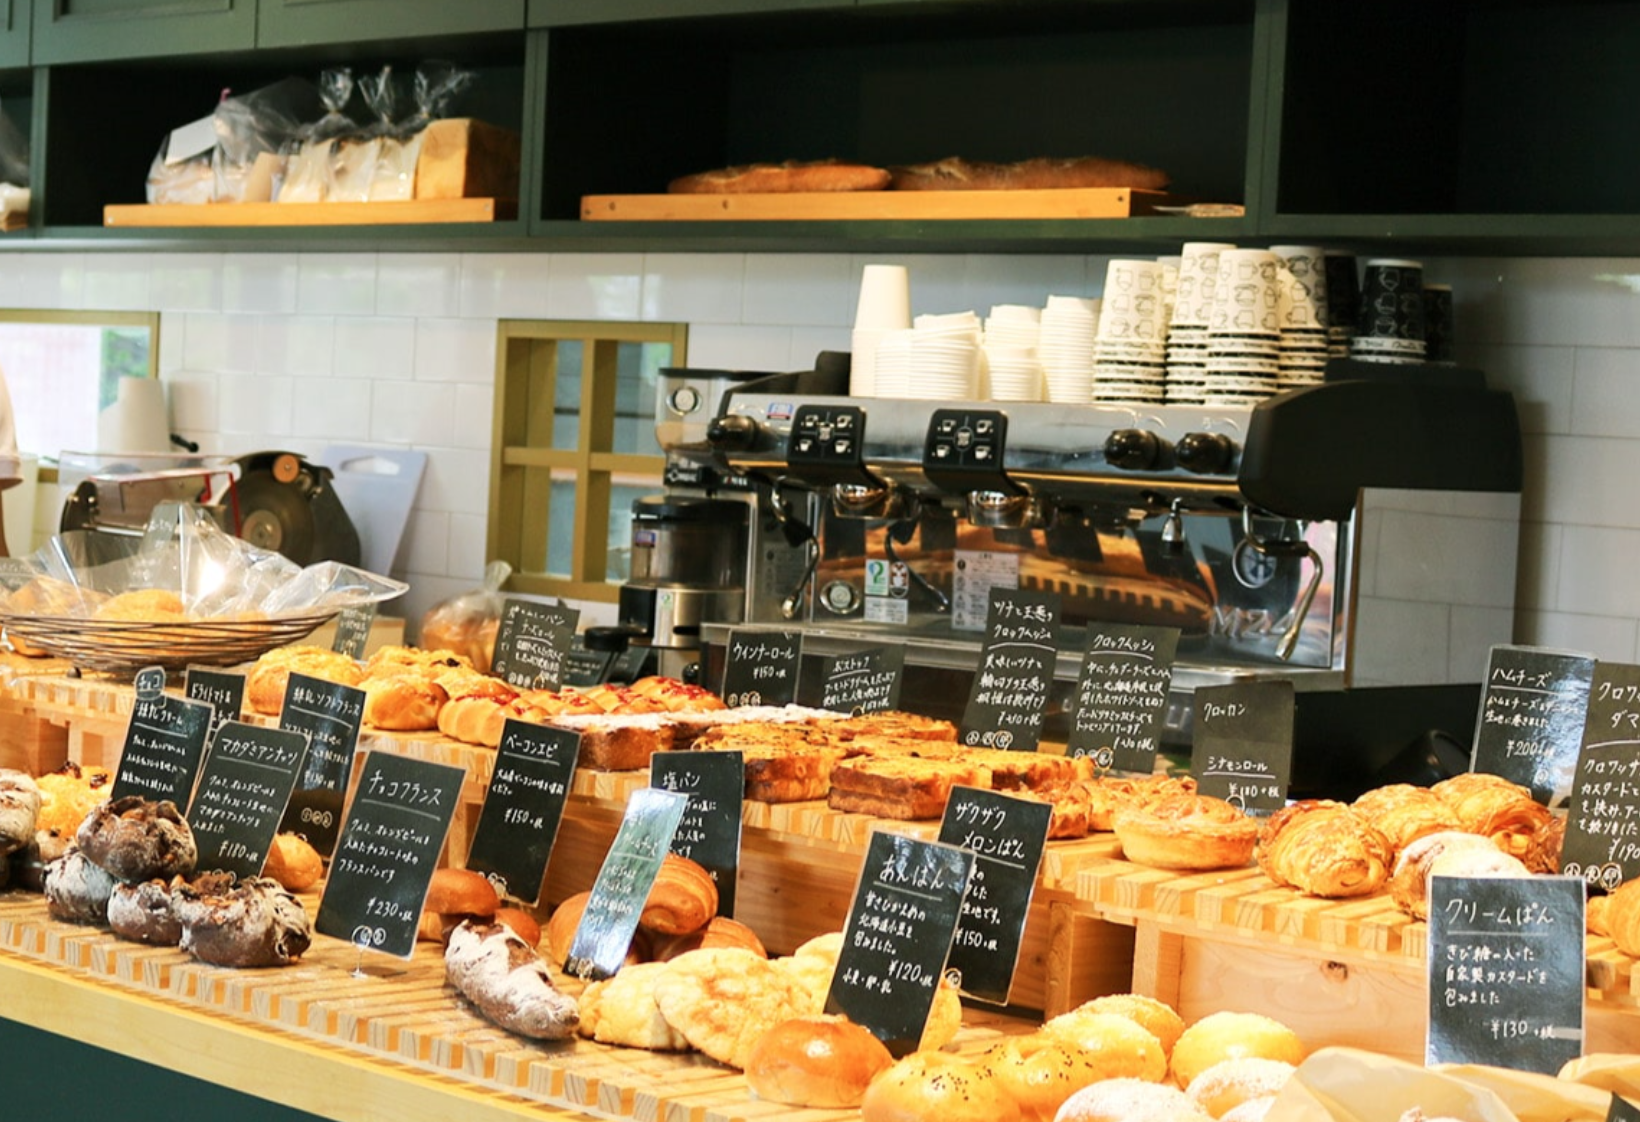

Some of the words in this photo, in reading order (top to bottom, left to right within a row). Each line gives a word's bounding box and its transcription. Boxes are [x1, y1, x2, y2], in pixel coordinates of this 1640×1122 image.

[1491, 667, 1552, 687] ハムチーズ
[221, 738, 298, 766] マカダミアンナッツ
[506, 734, 559, 759] ベーコンエピ
[1207, 756, 1268, 772] シナモンロール
[1584, 759, 1640, 778] クロワッサ
[369, 770, 442, 806] チョコフランス
[662, 771, 701, 790] 塩パン
[955, 802, 1007, 831] ザクザク
[1445, 899, 1554, 926] クリームぱん
[1445, 965, 1548, 985] 自家製カスタードを
[1445, 987, 1500, 1007] 包みました
